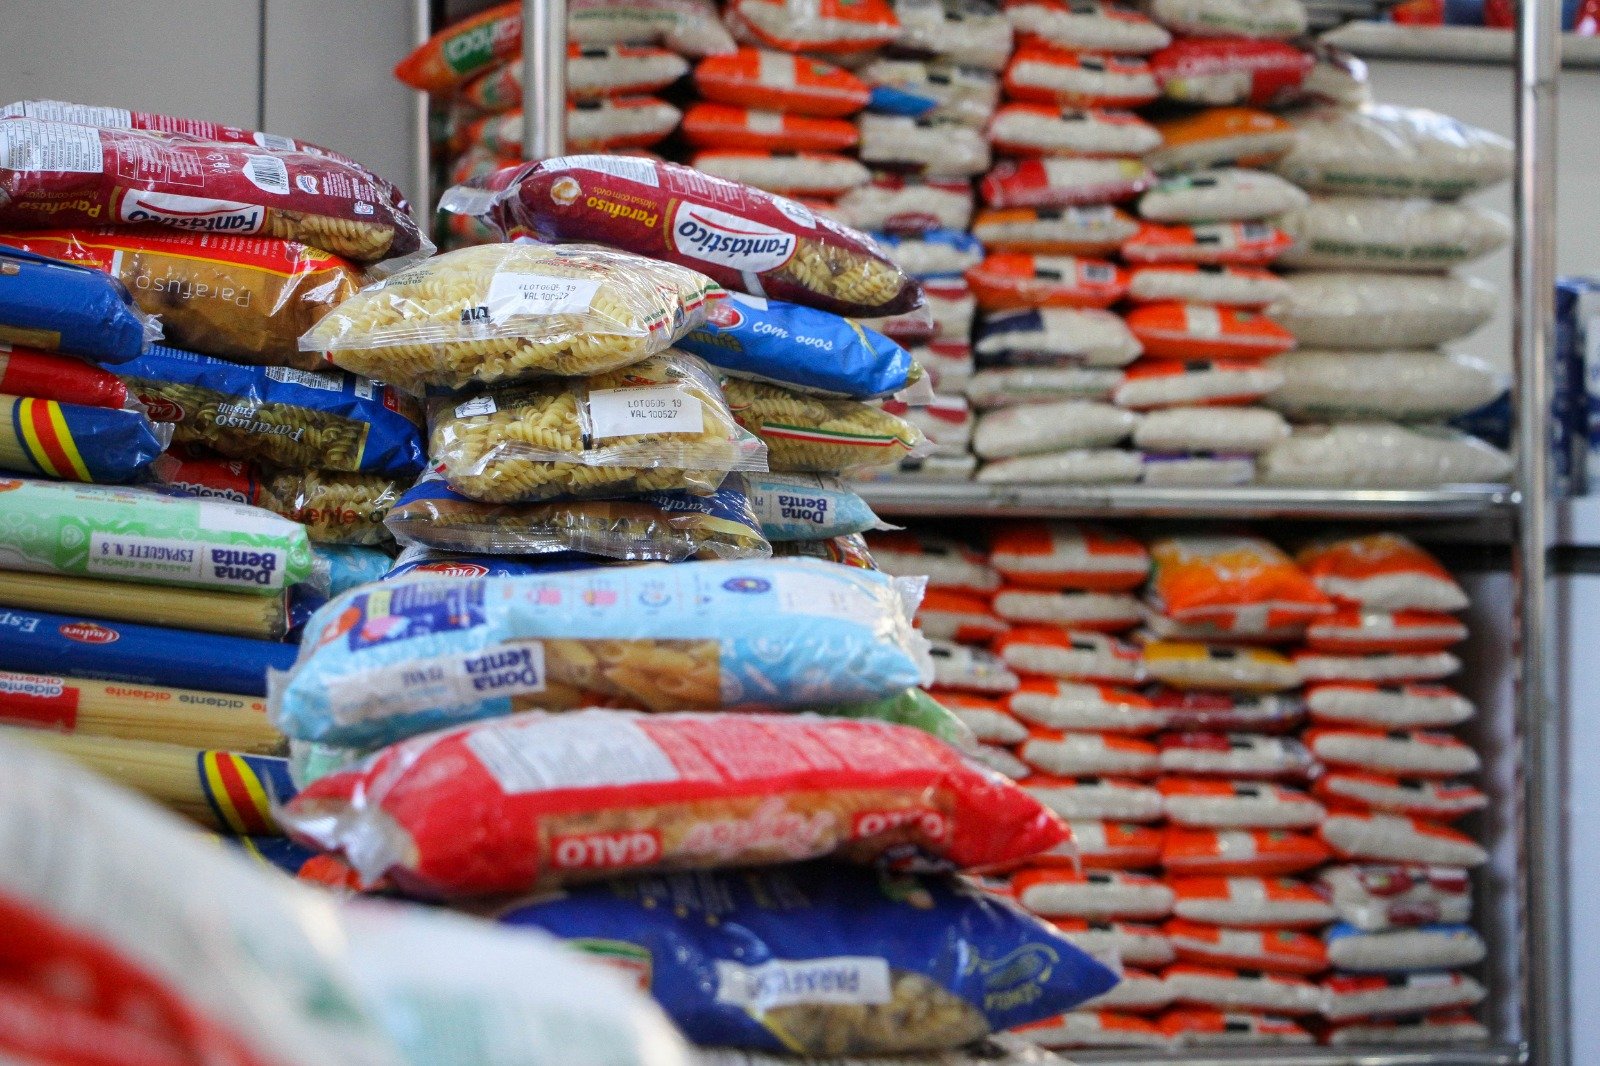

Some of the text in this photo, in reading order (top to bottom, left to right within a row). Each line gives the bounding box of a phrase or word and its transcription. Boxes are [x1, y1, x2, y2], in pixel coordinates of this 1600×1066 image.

[18, 200, 102, 218] Parafuso
[587, 196, 659, 228] Parafuso
[678, 221, 790, 258] Fantástico
[136, 275, 251, 308] Parafuso
[524, 292, 538, 300] VAL
[566, 284, 577, 292] 19
[753, 321, 833, 351] com ovos
[218, 402, 257, 418] Fusilli
[672, 399, 682, 408] 19
[631, 410, 678, 418] VAL 100527
[215, 414, 305, 442] Parafuso
[172, 483, 245, 504] ldente
[779, 495, 828, 512] Benta
[781, 507, 825, 524] Dona
[101, 541, 109, 554] 8
[128, 544, 194, 563] ESPAGUETE
[212, 548, 276, 571] Benta
[215, 566, 271, 585] Dona
[472, 669, 538, 691] Dona
[105, 686, 171, 702] aldente
[179, 692, 244, 709] aldente
[857, 808, 946, 839] GO
[556, 831, 658, 867] GALO
